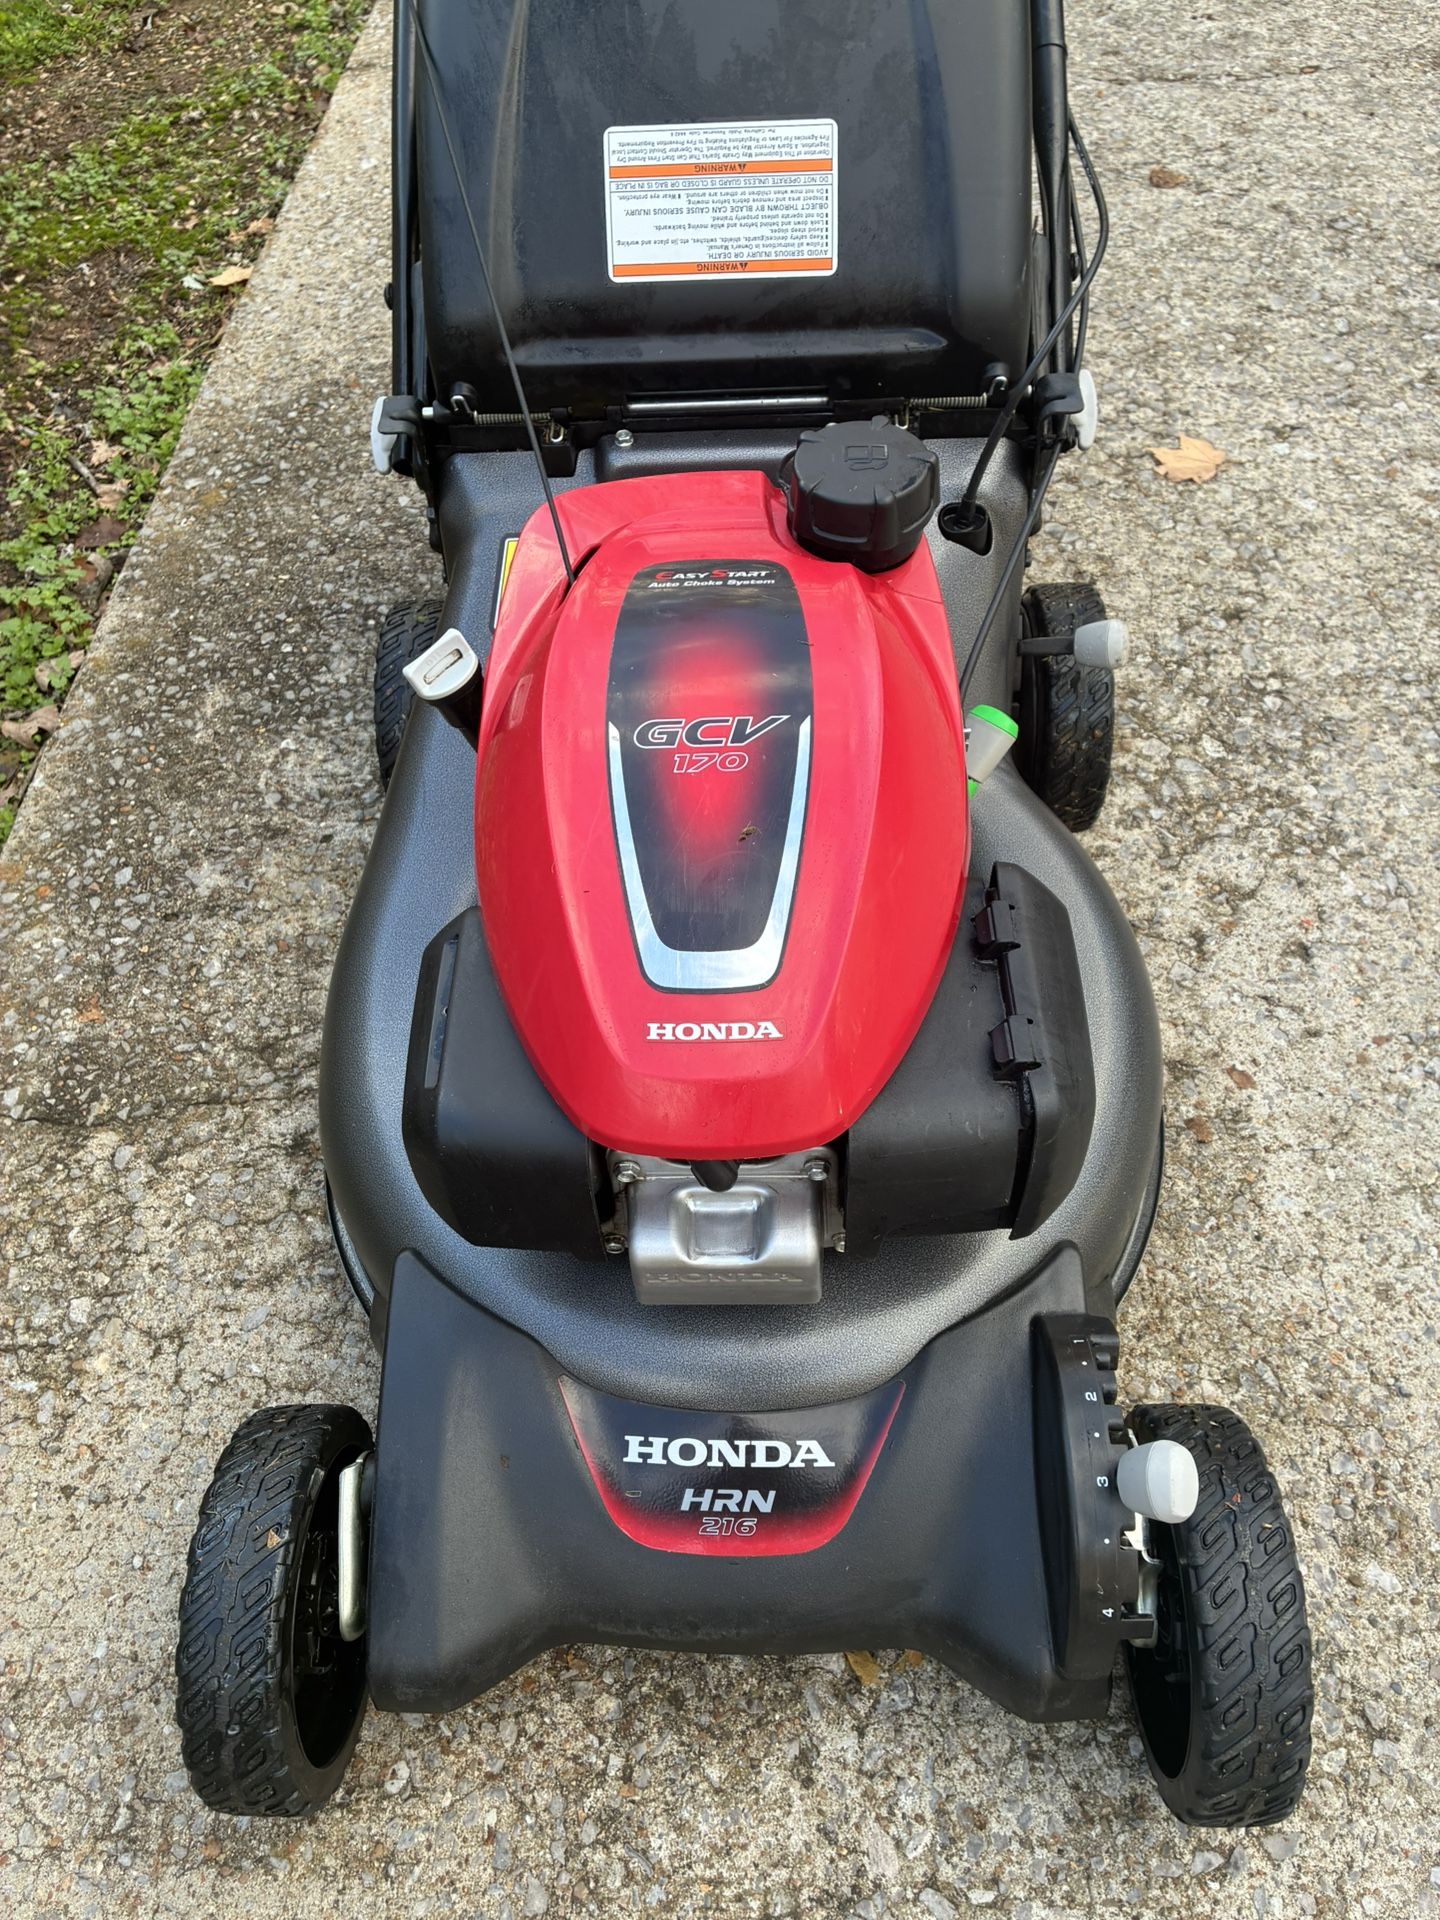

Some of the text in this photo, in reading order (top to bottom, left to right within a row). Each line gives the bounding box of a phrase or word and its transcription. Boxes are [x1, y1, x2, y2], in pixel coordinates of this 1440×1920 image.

[728, 136, 759, 144] Regulations
[693, 163, 736, 172] WARNING
[742, 177, 769, 185] UNLESS
[771, 176, 801, 184] OPERATE
[652, 207, 683, 215] SERIOUS
[800, 202, 828, 210] OBJECT
[696, 262, 738, 271] WARNING
[656, 570, 770, 580] EASY START
[633, 714, 791, 749] GCV
[673, 752, 748, 773] 170
[646, 1022, 783, 1040] HONDA
[646, 1272, 803, 1283] HONDA
[1085, 1391, 1098, 1401] 2
[623, 1435, 836, 1468] HONDA
[1096, 1476, 1108, 1488] 3
[680, 1488, 776, 1512] HRN
[698, 1517, 758, 1536] 216
[1102, 1608, 1114, 1618] 4
